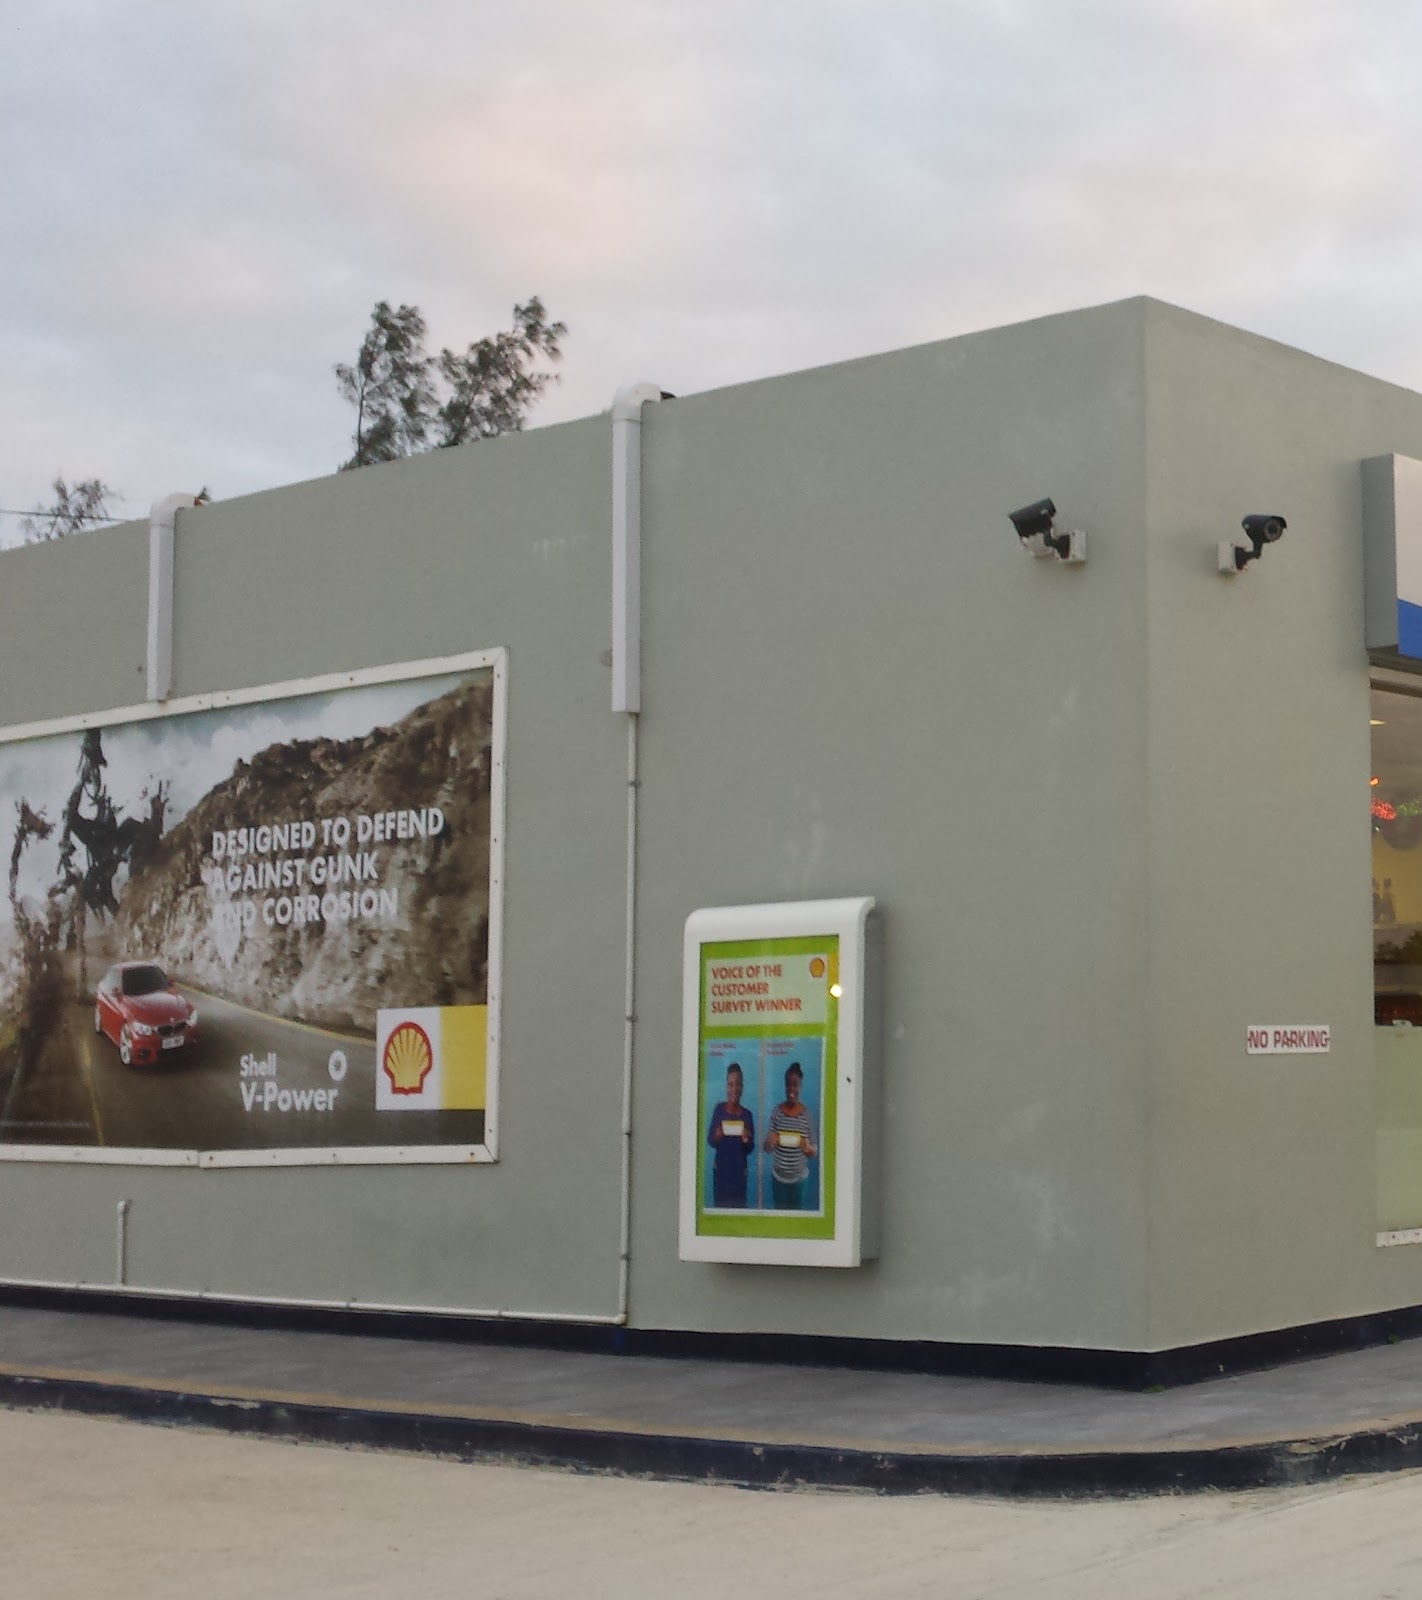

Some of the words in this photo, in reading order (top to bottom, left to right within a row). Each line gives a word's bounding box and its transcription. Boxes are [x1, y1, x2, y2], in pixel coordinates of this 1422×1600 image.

[212, 821, 316, 858] DESIGNED
[321, 816, 350, 846] TO
[357, 807, 445, 843] DEFEND
[211, 858, 305, 892] AGAINST
[310, 851, 379, 885] GUNK
[262, 888, 399, 925] CORROSION
[711, 966, 743, 980] VOICE
[746, 965, 761, 978] OF
[763, 964, 782, 978] THE
[711, 982, 769, 997] CUSTOMER
[711, 1000, 751, 1014] SURVEY
[755, 998, 802, 1012] WINNER
[1249, 1030, 1268, 1049] NO
[1274, 1030, 1328, 1048] PARKING
[240, 1052, 276, 1077] Shell
[240, 1081, 339, 1112] V-Power
